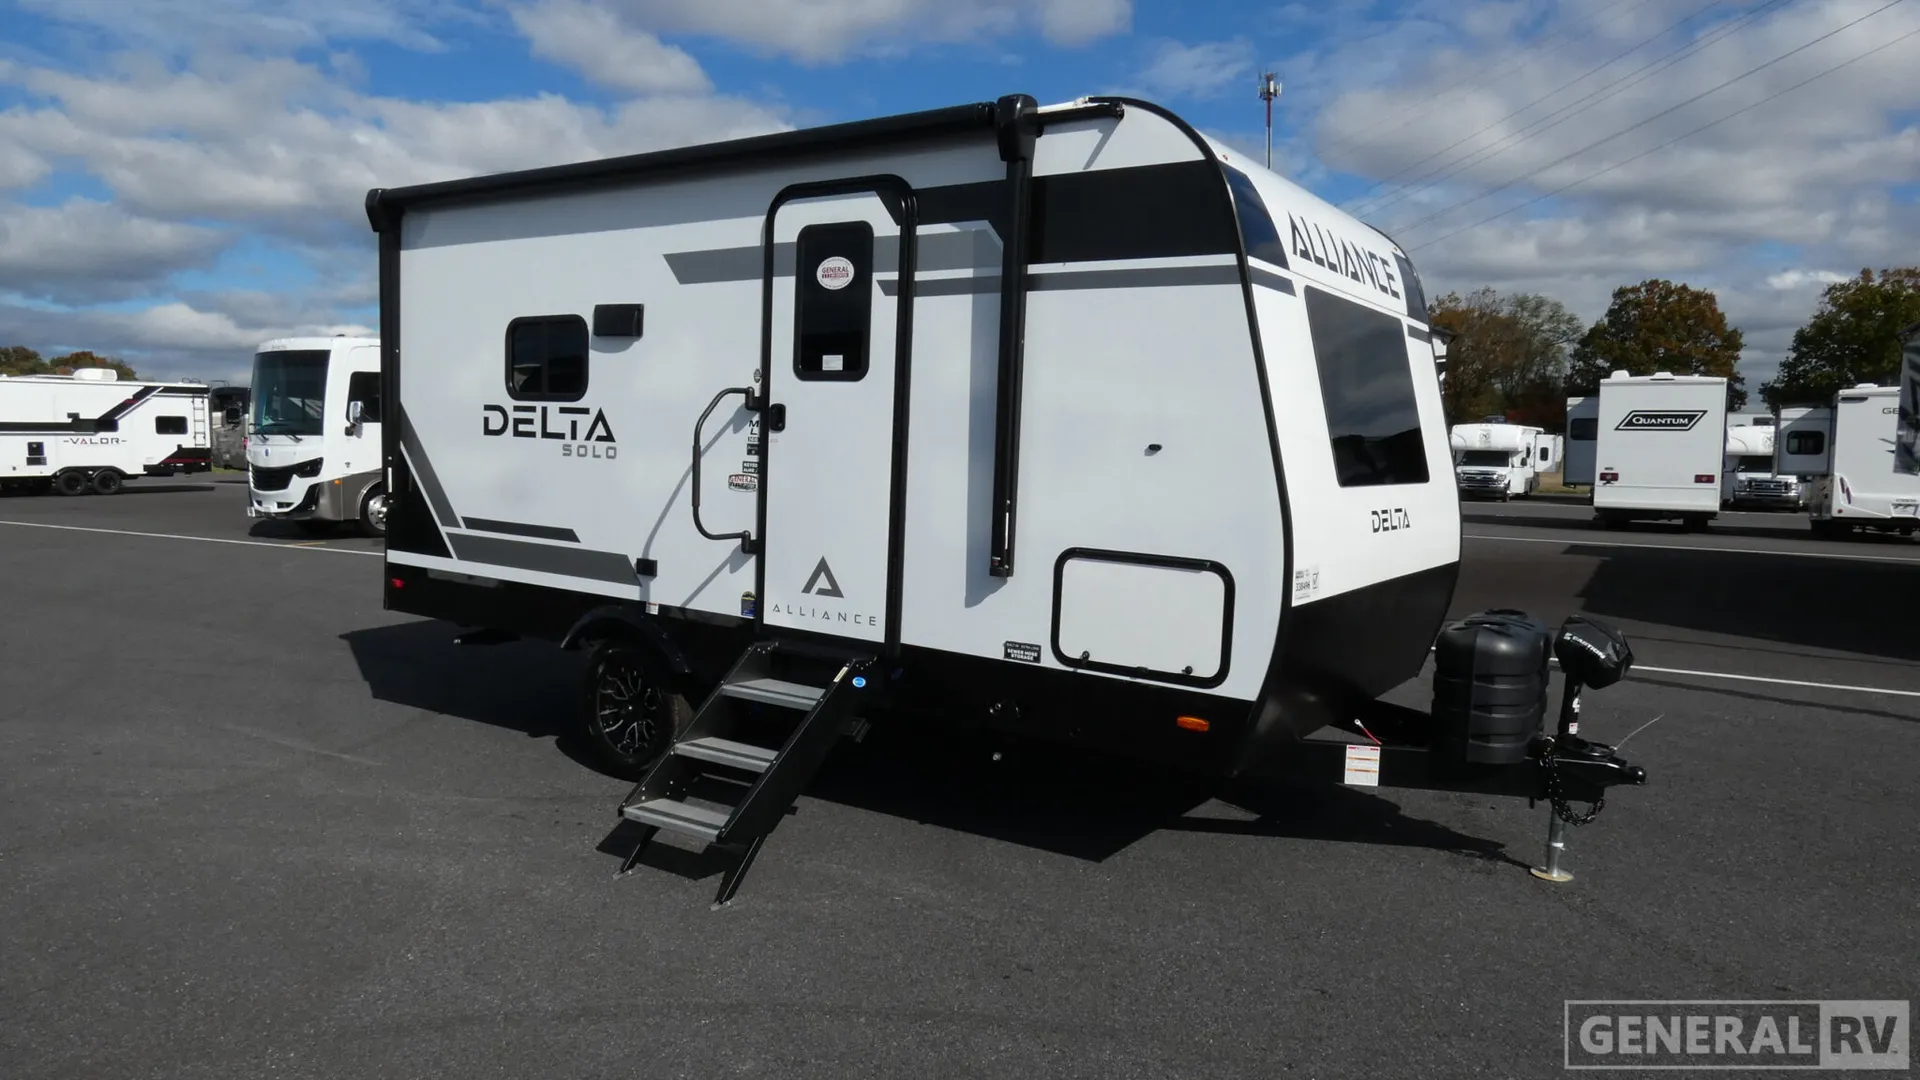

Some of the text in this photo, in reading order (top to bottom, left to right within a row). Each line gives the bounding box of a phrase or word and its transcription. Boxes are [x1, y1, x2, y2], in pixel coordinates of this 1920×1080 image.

[1287, 211, 1401, 300] ALLIANCE
[821, 266, 849, 274] GENERAL
[483, 404, 617, 443] DELTA
[562, 443, 617, 460] SOLO
[1371, 507, 1411, 533] DELTA
[772, 603, 877, 627] ALLIANCE
[1011, 653, 1034, 661] STORAGE
